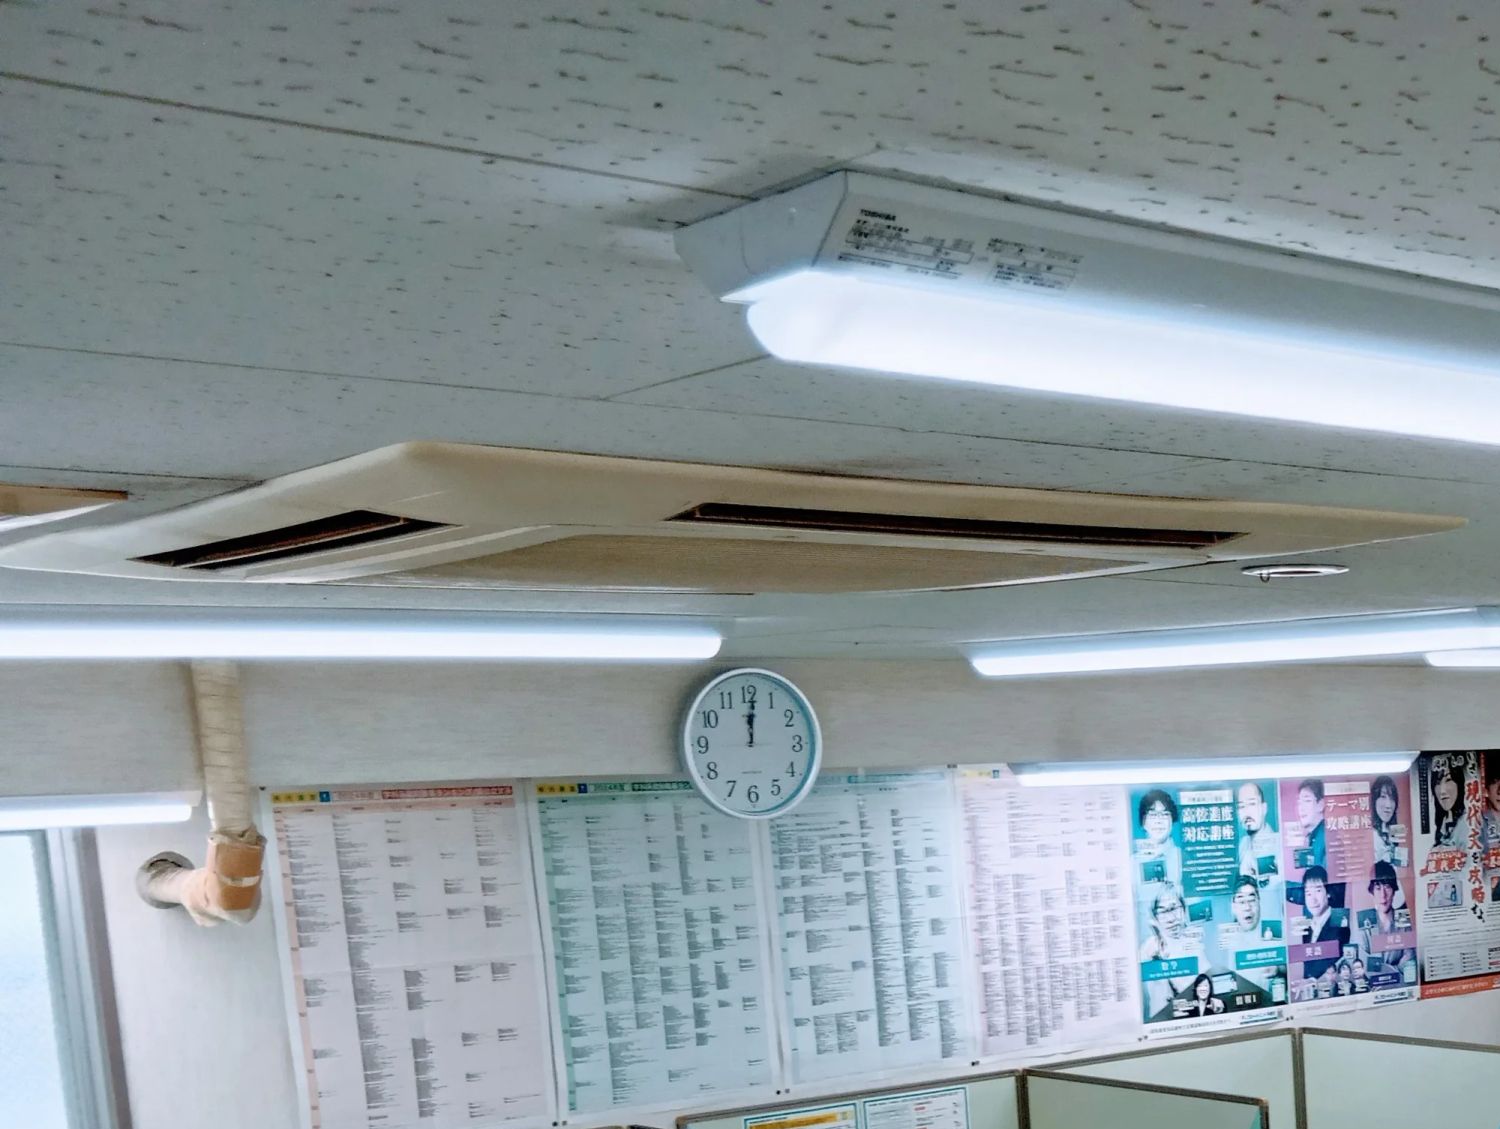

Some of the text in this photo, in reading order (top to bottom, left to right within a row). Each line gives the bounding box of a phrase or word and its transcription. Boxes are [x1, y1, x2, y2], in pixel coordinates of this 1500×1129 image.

[719, 691, 733, 710] 11
[741, 685, 757, 704] 12
[767, 692, 774, 710] 1
[702, 709, 719, 729] 10
[783, 709, 795, 728] 2
[696, 735, 709, 755] 9
[791, 734, 804, 753] 3
[706, 761, 719, 781] 8
[785, 761, 796, 778] 4
[726, 779, 737, 798] 7
[747, 784, 760, 804] 6
[770, 778, 781, 797] 5
